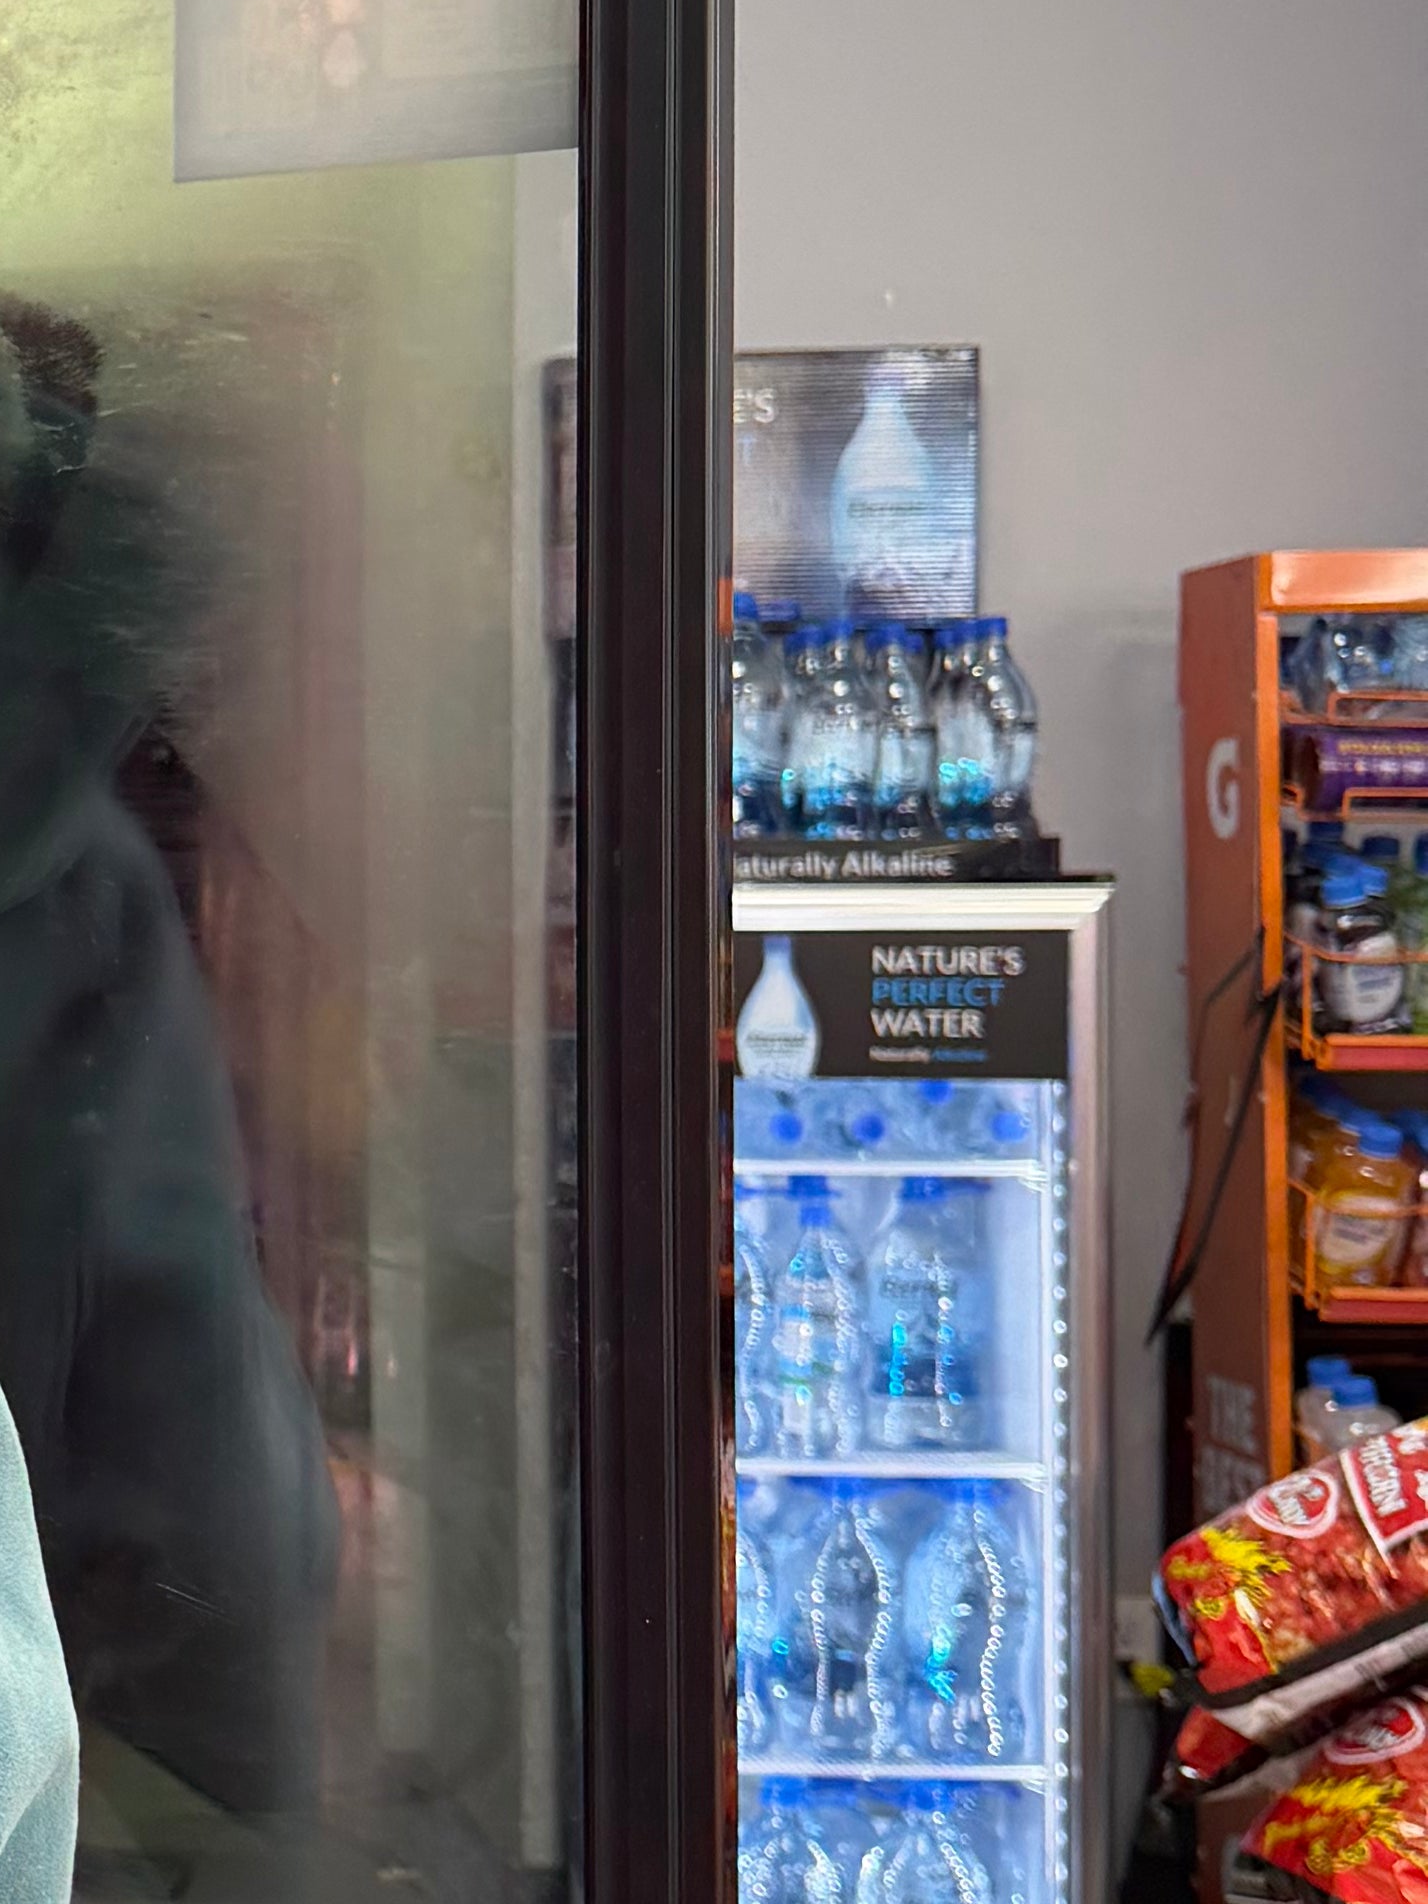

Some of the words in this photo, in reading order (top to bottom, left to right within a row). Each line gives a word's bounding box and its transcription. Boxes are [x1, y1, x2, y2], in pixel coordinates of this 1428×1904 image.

[1206, 736, 1242, 842] G
[733, 850, 838, 881] aturally
[840, 850, 956, 880] Alkaline
[871, 944, 1026, 977] NATURE'S
[871, 976, 1005, 1008] PERFECT
[870, 1007, 986, 1040] WATER
